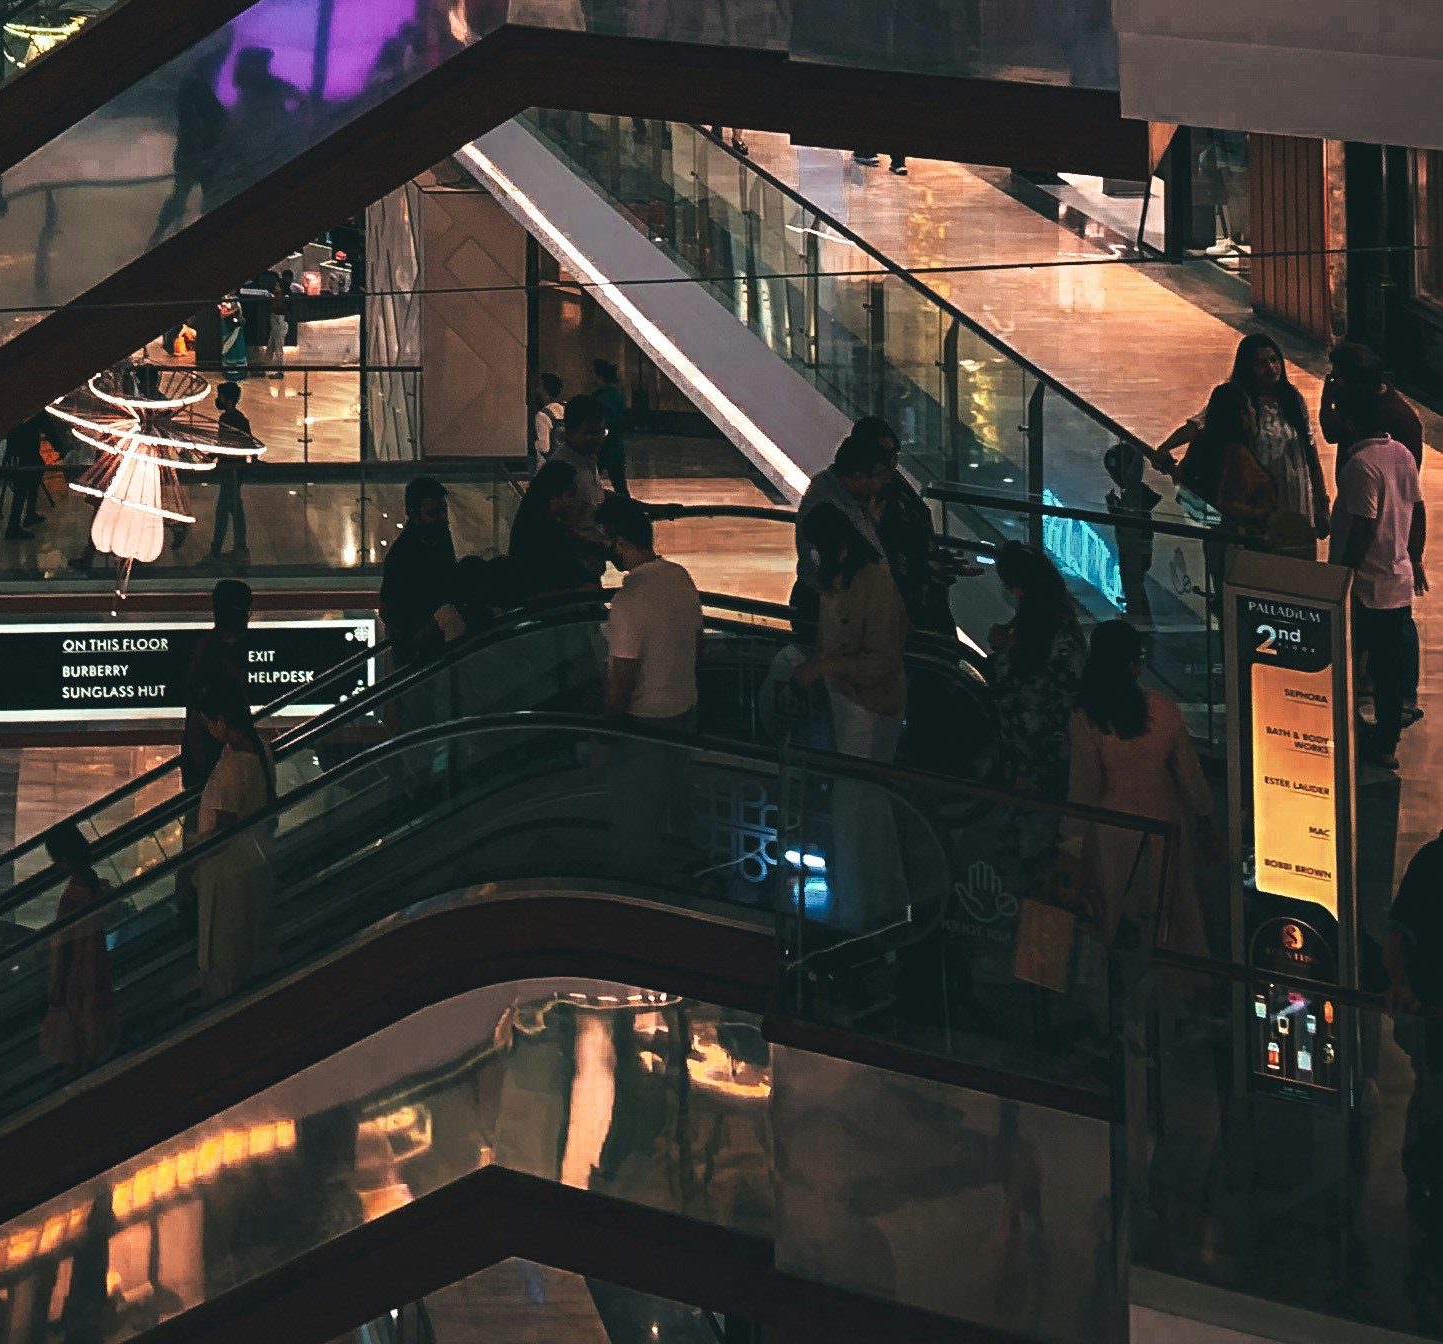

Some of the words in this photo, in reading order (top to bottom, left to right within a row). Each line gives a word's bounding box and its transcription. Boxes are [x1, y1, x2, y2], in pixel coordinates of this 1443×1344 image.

[1248, 601, 1320, 623] PALLADIUM
[63, 639, 86, 652] ON
[90, 639, 119, 651] THIS
[123, 638, 169, 650] FLOOR
[1256, 624, 1301, 655] 2nd
[248, 651, 275, 662] EXIT
[62, 665, 129, 677] BURBERRY
[248, 671, 314, 683] HELPDESK
[62, 686, 135, 699] SUNGLASS
[138, 685, 166, 697] HUT
[1284, 688, 1328, 704] SEPHORA
[1266, 726, 1291, 738] BATH
[1303, 733, 1329, 744] BODY
[1294, 741, 1329, 754] WORKS
[1293, 781, 1330, 795] LAUDER
[1308, 826, 1330, 837] MAC
[1264, 858, 1292, 870] BOBBI
[1295, 865, 1331, 878] BROWN
